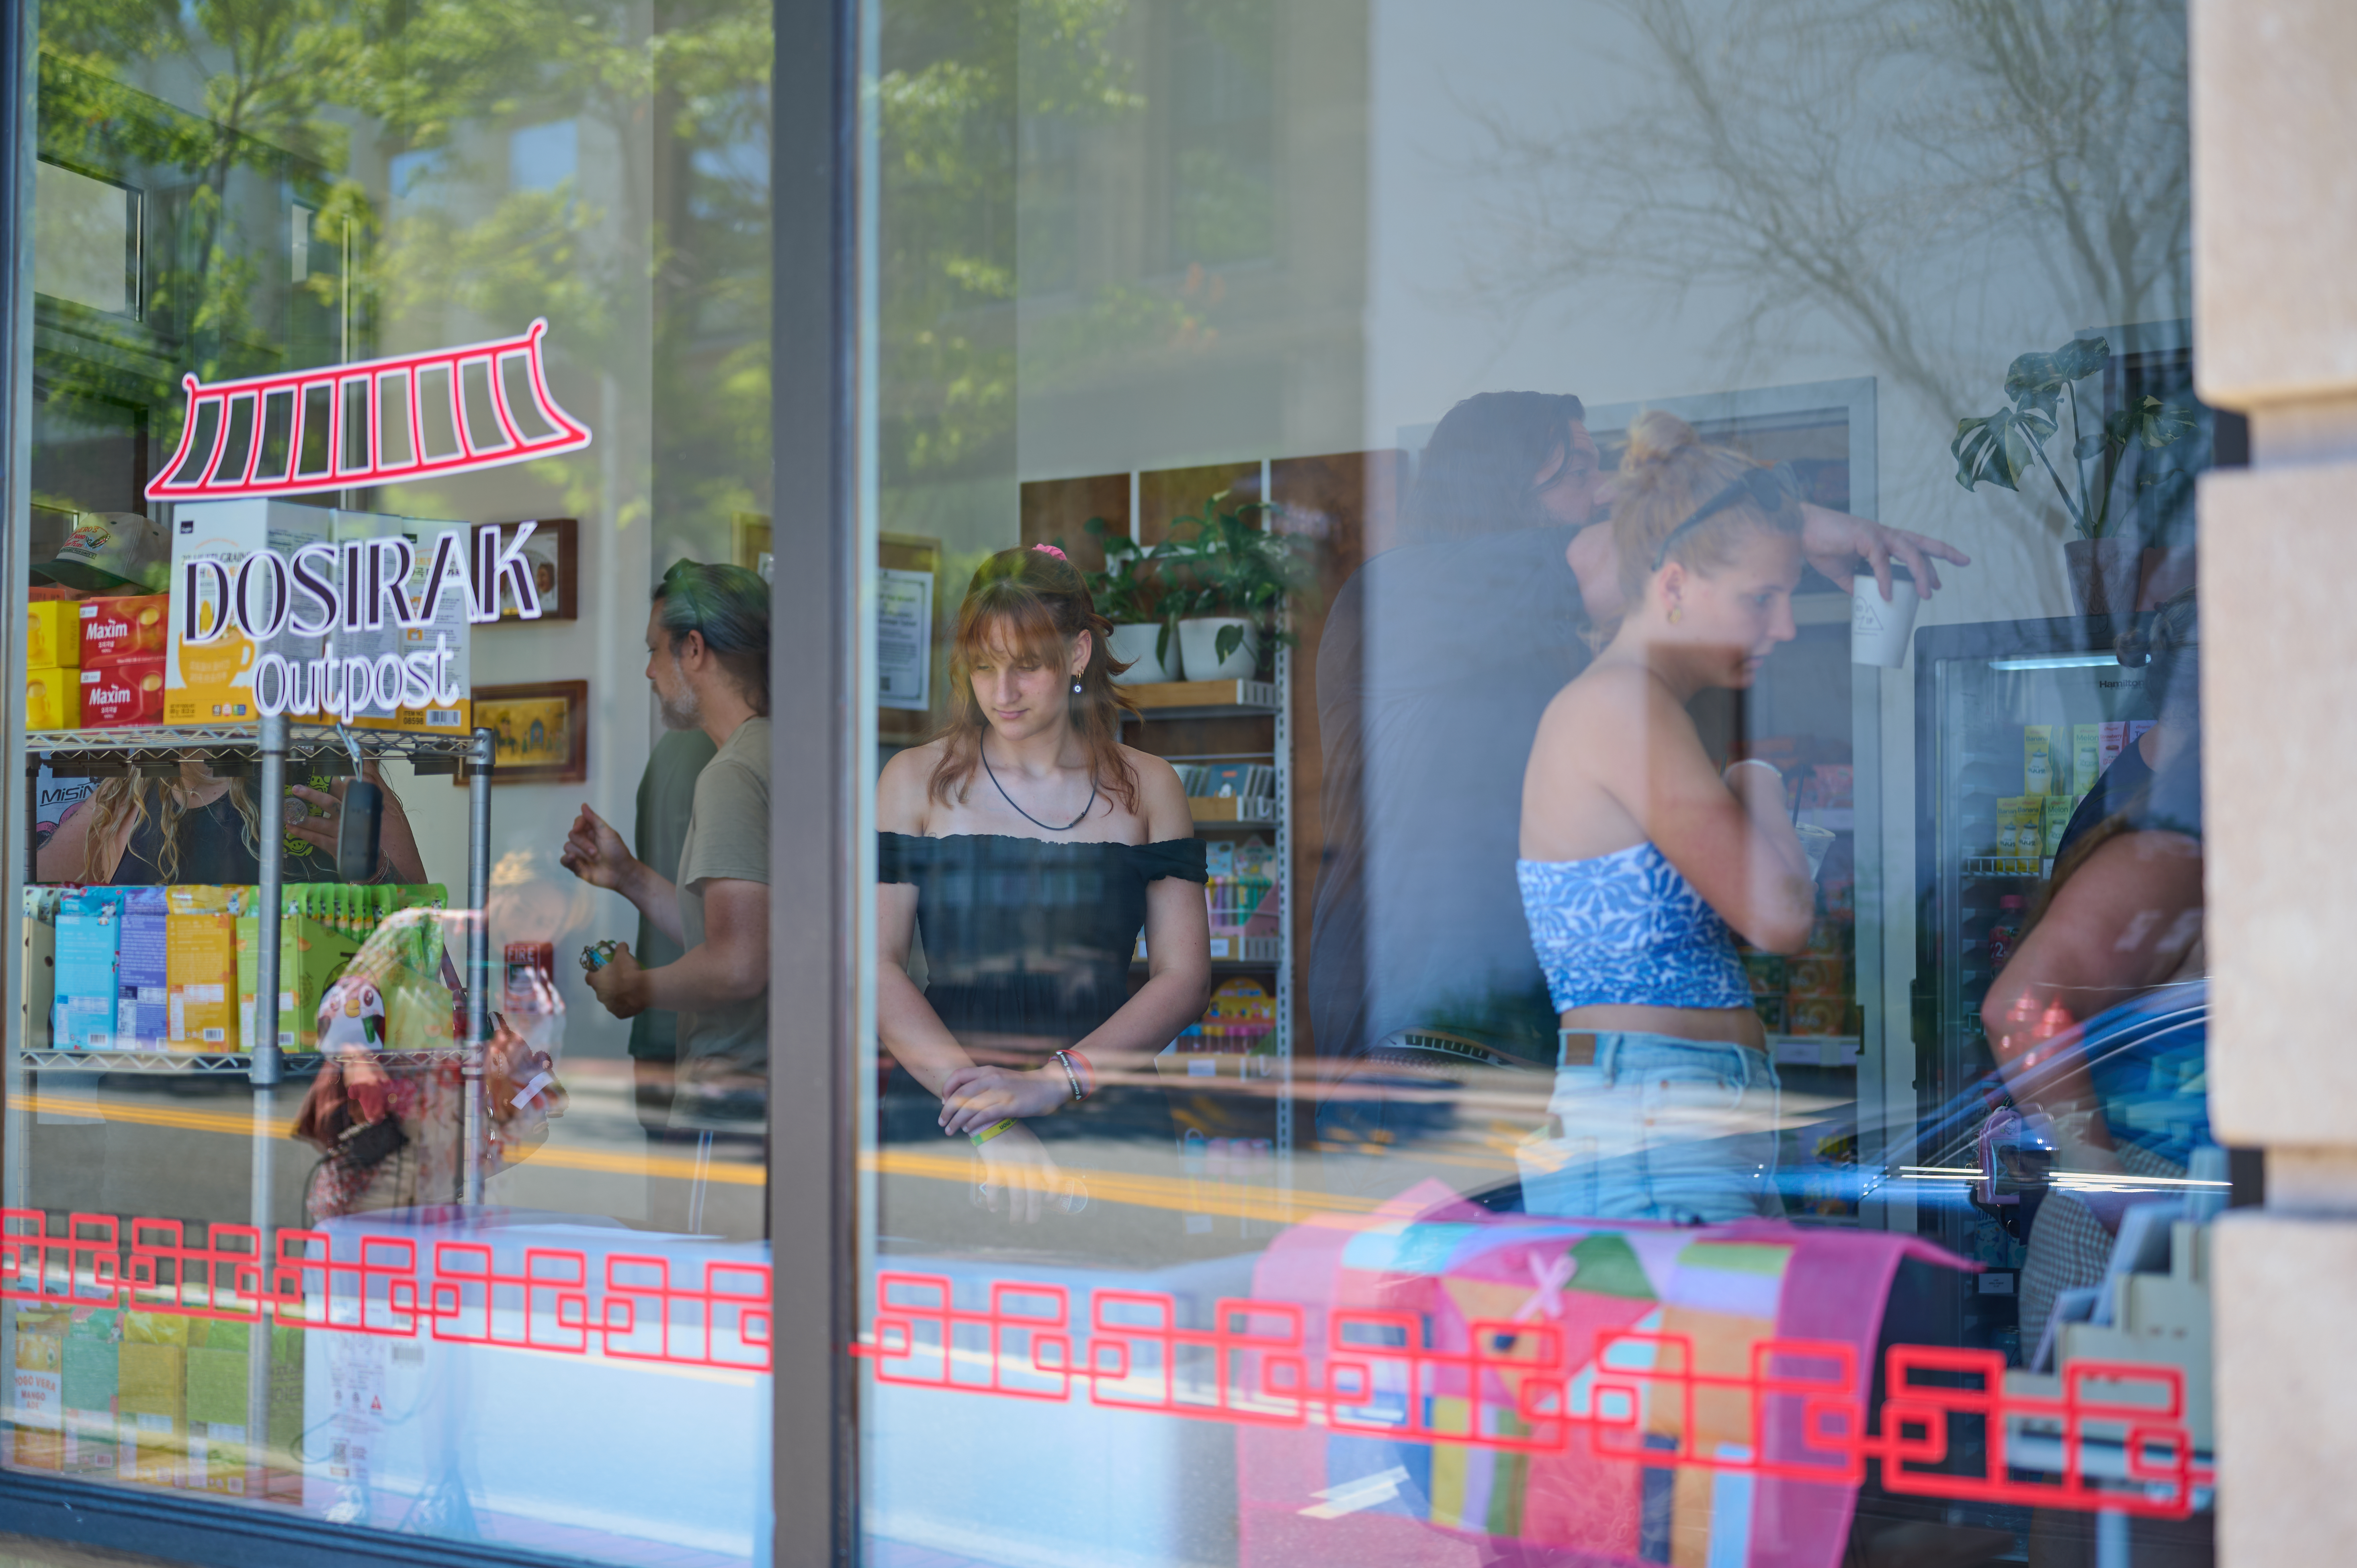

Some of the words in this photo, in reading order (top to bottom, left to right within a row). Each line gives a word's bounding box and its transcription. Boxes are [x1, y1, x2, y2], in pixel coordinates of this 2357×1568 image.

[183, 520, 542, 644] DOSIRAK
[86, 618, 128, 640] Maxim
[2099, 679, 2144, 688] Hamilton
[89, 683, 131, 705] Maxim
[2076, 734, 2099, 742] Melon
[2048, 805, 2068, 813] Melon
[508, 947, 534, 962] FIRE
[1060, 1054, 1069, 1066] Space
[1060, 1197, 1069, 1212] TIRED
[35, 1376, 56, 1392] VERA
[21, 1390, 45, 1401] MANGO
[27, 1400, 39, 1410] ADE
